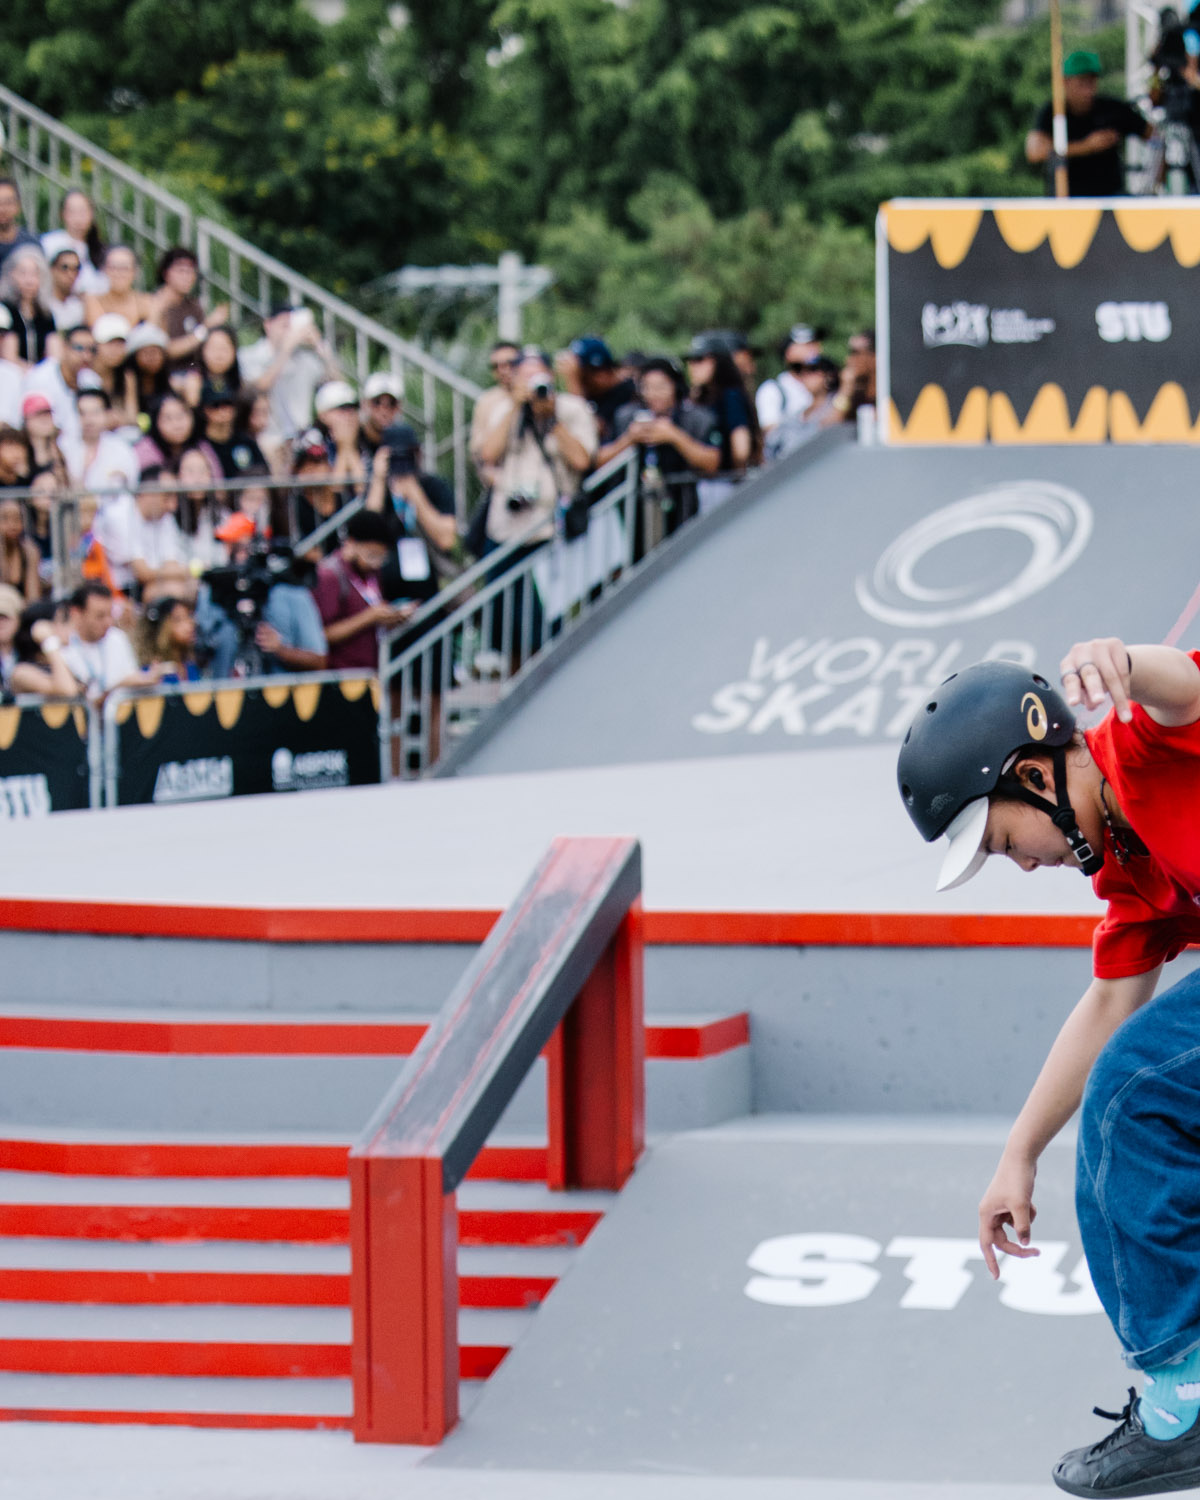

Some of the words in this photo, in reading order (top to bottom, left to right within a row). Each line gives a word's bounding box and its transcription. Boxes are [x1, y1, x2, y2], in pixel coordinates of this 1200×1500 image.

[1096, 302, 1171, 342] STU
[694, 683, 934, 735] SKAT
[743, 1231, 1106, 1316] STU
